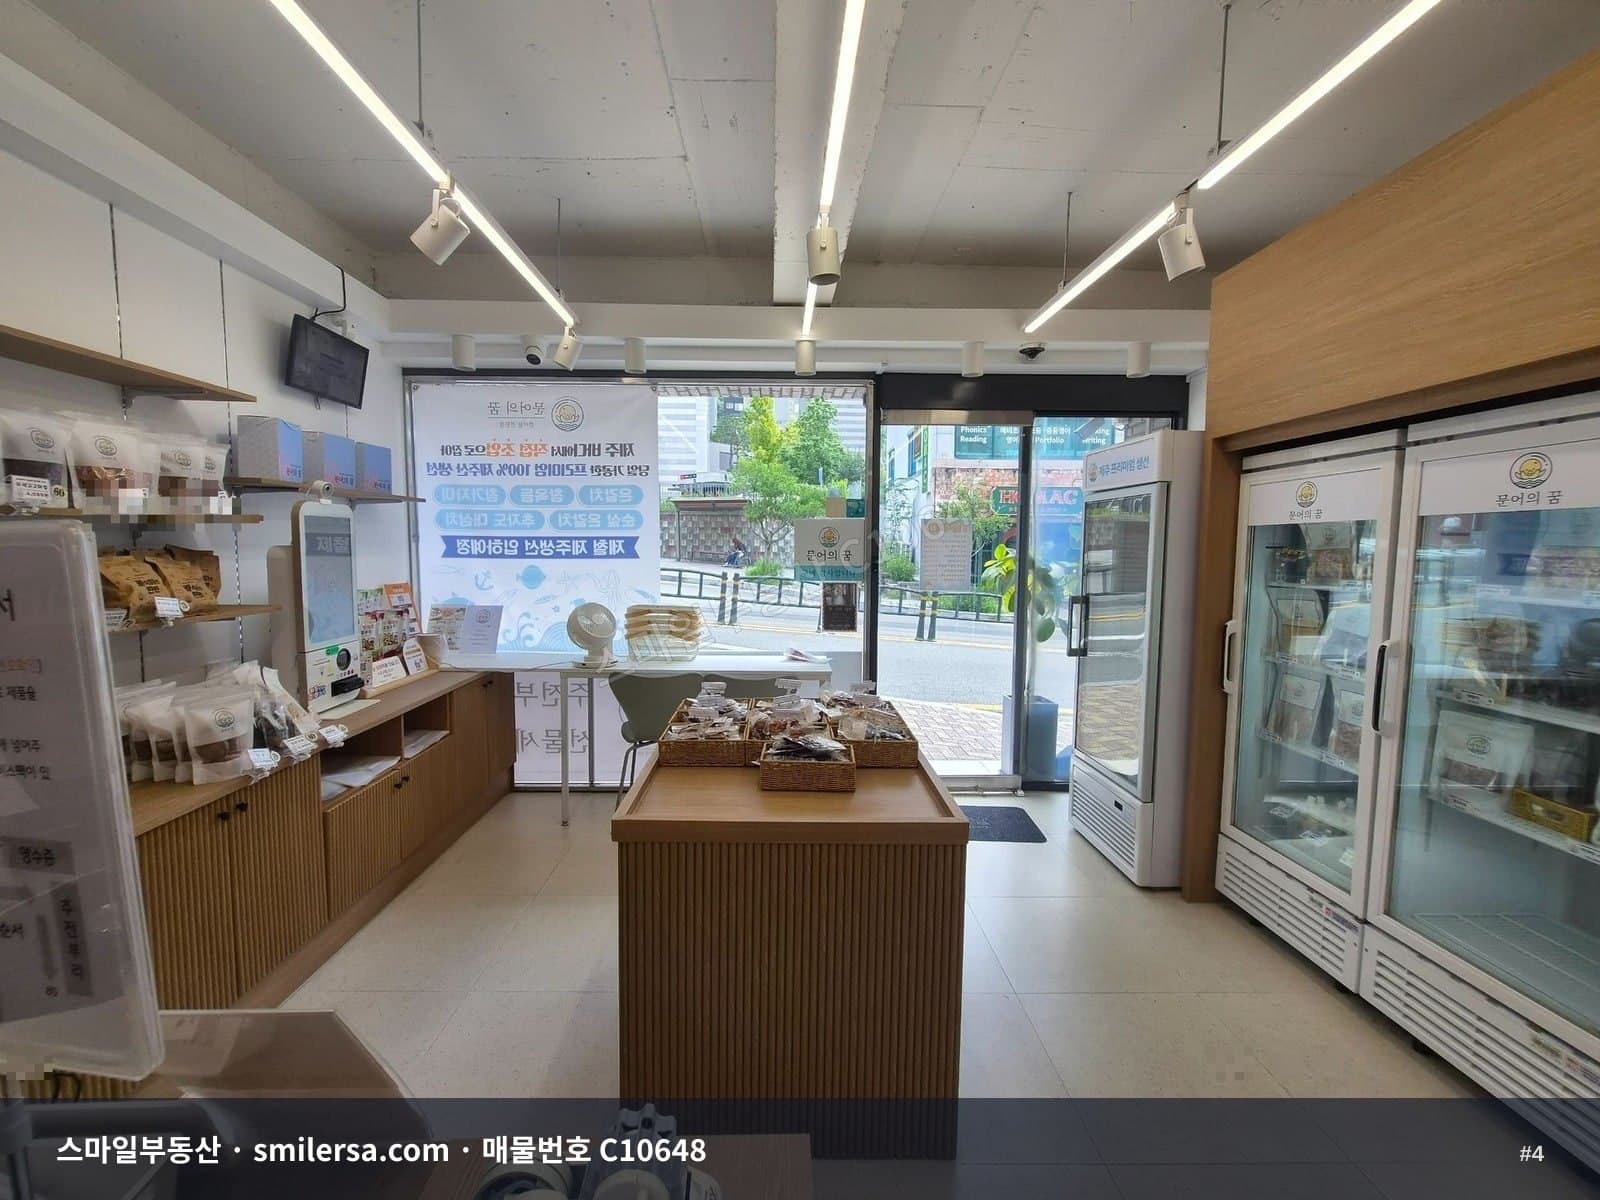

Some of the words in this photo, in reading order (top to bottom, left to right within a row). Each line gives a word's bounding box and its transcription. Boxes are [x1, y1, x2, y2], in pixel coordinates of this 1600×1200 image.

[960, 435, 987, 444] Reading
[1496, 491, 1540, 507] 문어의
[1547, 490, 1564, 505] 꿈
[1288, 508, 1311, 521] 문어의
[806, 549, 838, 562] 문어의
[842, 550, 853, 562] 꿈
